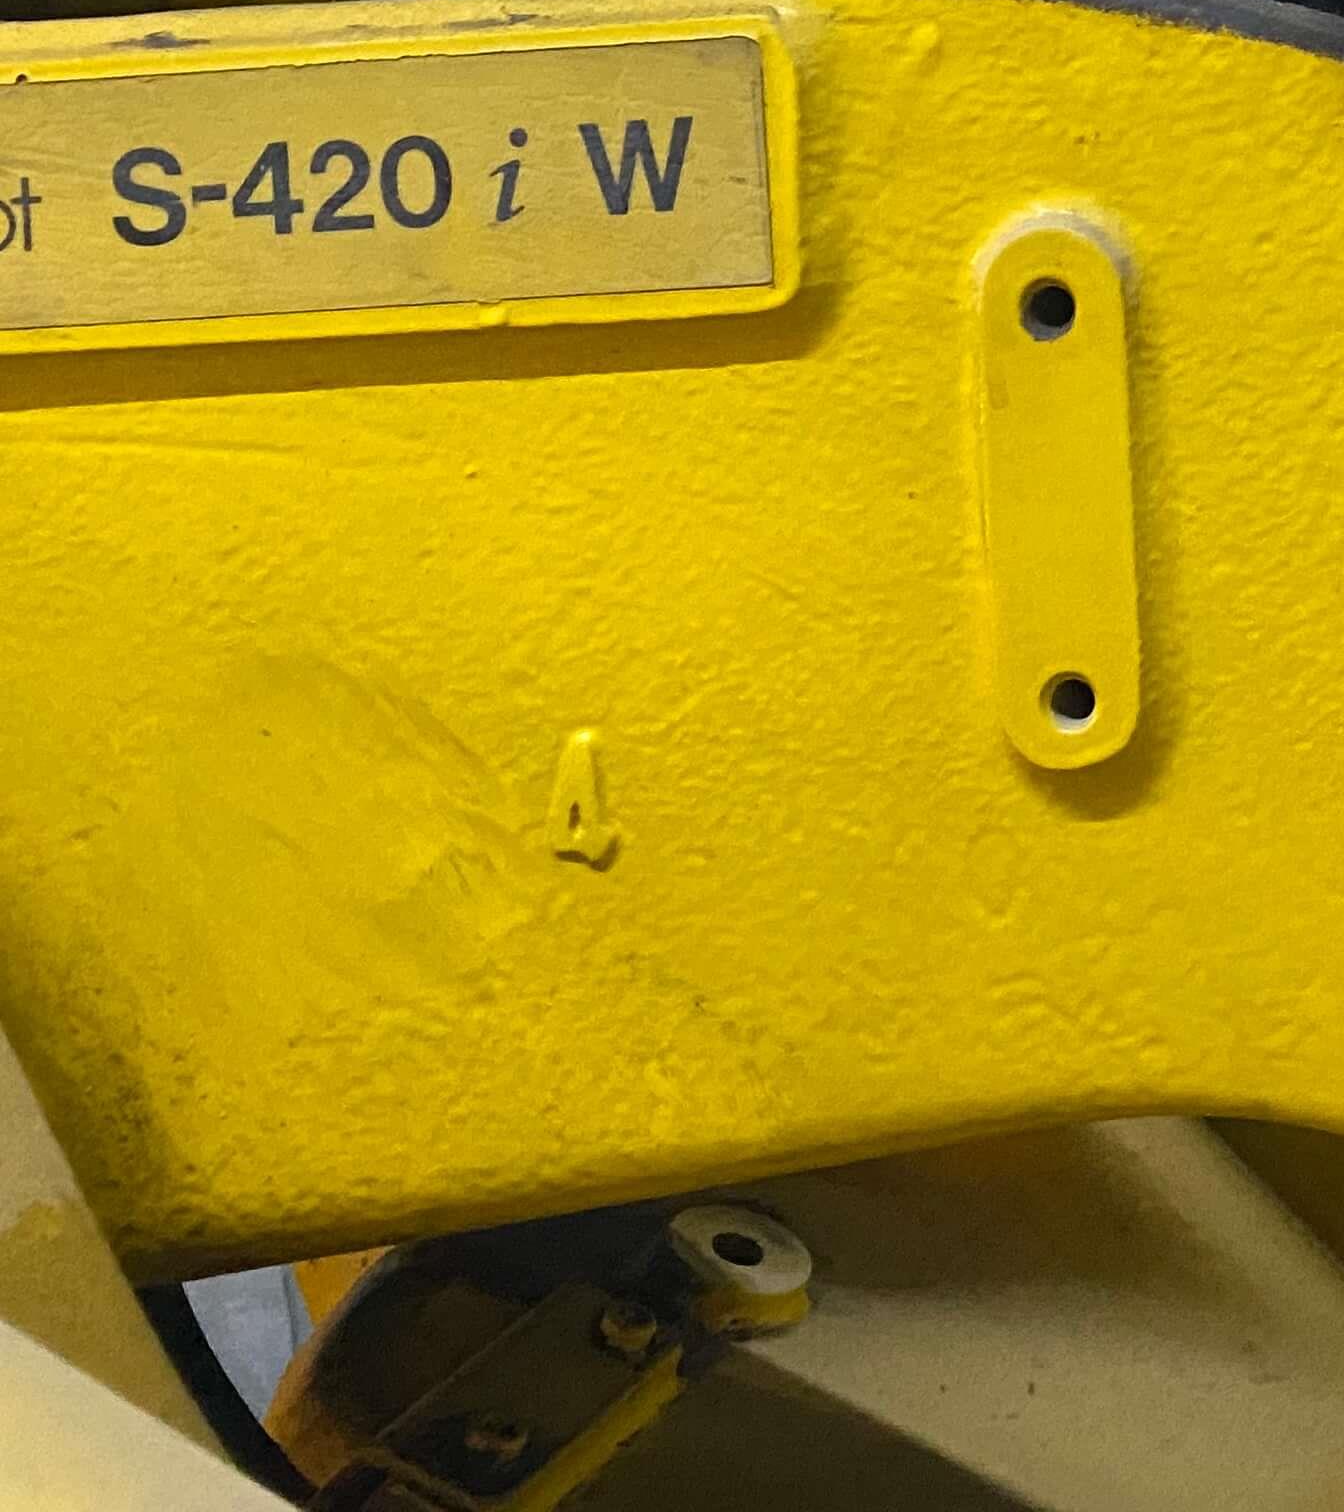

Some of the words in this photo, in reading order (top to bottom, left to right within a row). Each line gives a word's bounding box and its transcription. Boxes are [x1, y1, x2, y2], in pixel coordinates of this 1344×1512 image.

[111, 134, 453, 248] S-420
[488, 127, 528, 223] i
[577, 115, 694, 216] W
